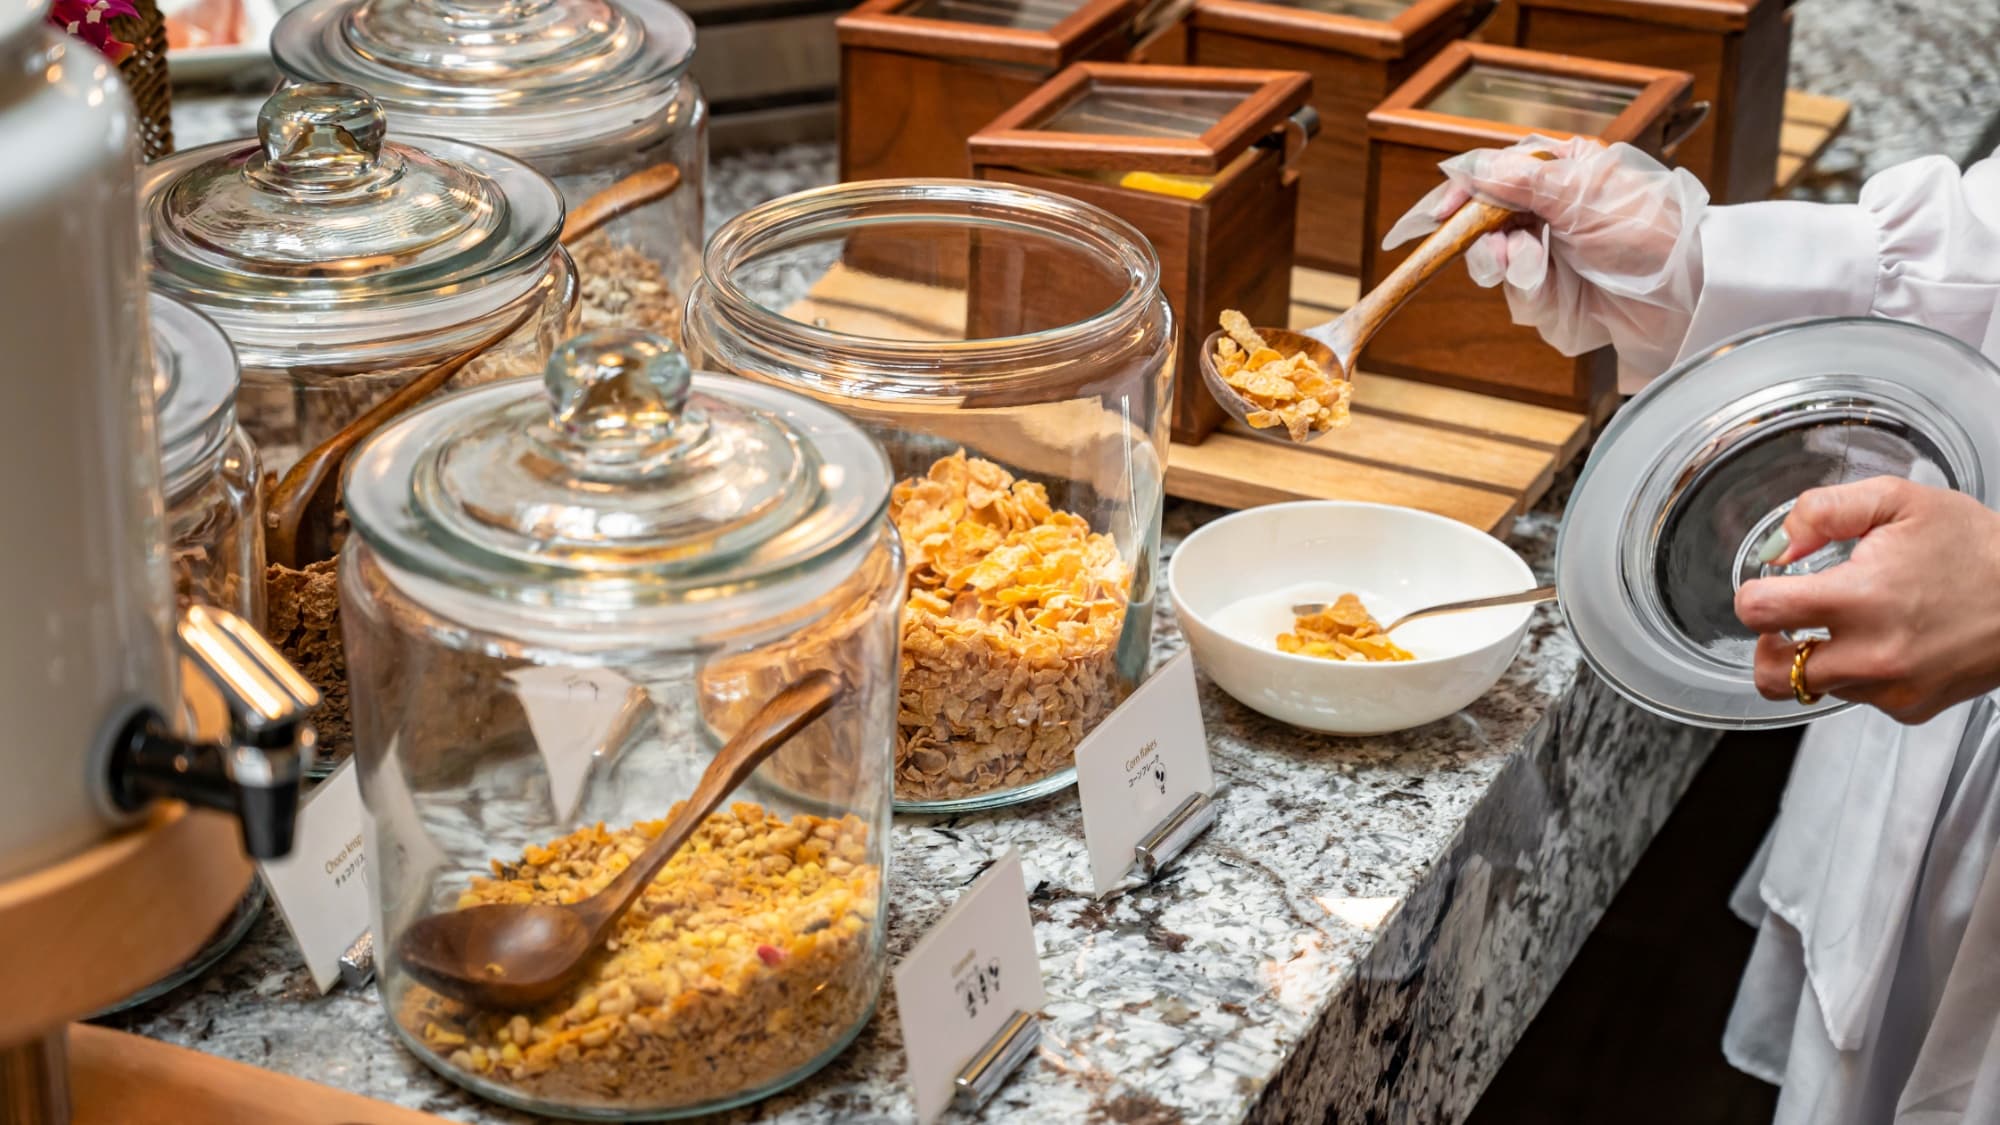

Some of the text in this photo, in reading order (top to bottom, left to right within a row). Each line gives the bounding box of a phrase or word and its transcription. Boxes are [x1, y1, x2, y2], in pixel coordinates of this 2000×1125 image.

[1125, 739, 1158, 773] Corn flakes
[325, 850, 347, 874] Choco
